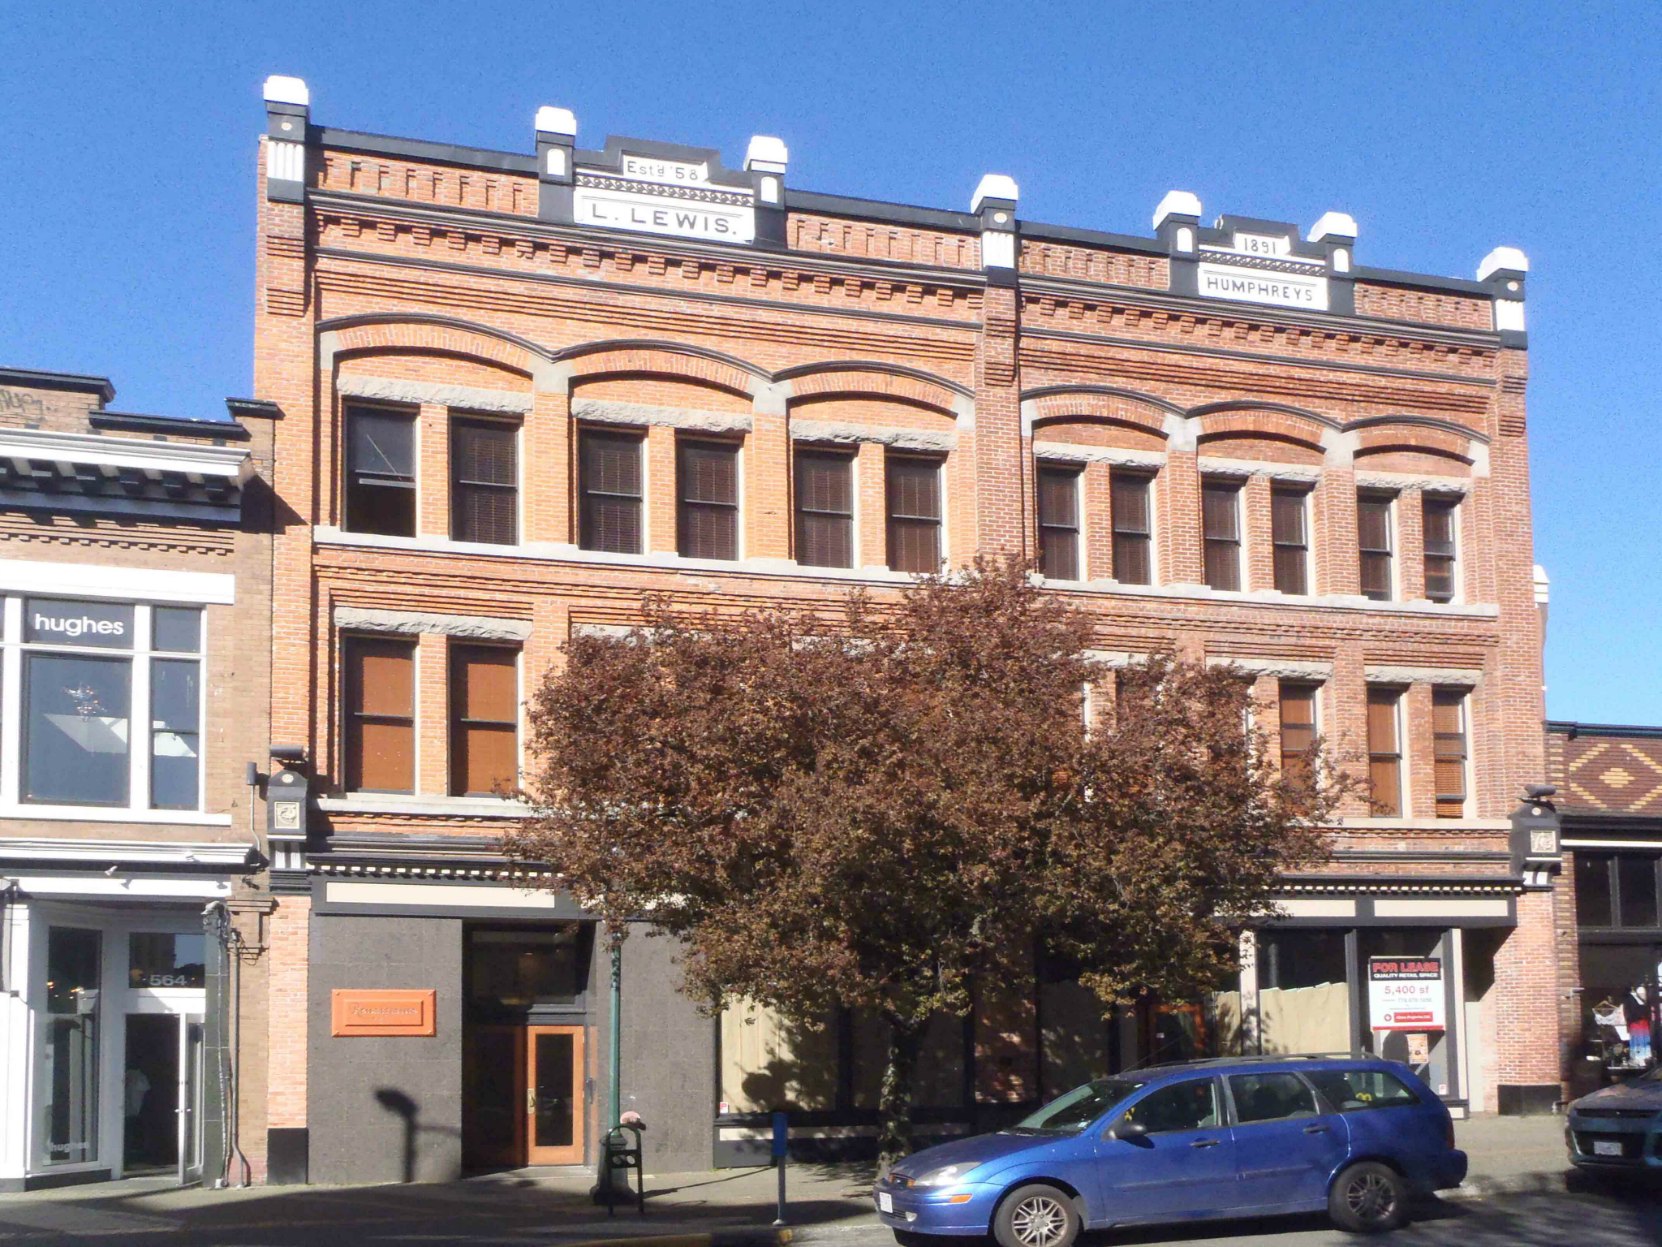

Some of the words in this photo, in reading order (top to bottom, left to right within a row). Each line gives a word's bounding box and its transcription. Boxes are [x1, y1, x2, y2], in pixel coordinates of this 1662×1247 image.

[591, 203, 619, 221] L.
[631, 207, 737, 235] LEWIS.
[1243, 238, 1276, 255] 1891
[1207, 276, 1313, 302] HUMPHREYS
[34, 613, 125, 637] hughes
[1372, 962, 1398, 973] FOR
[1400, 961, 1439, 973] LEASE
[149, 974, 187, 987] 564
[1384, 985, 1416, 996] 5,400
